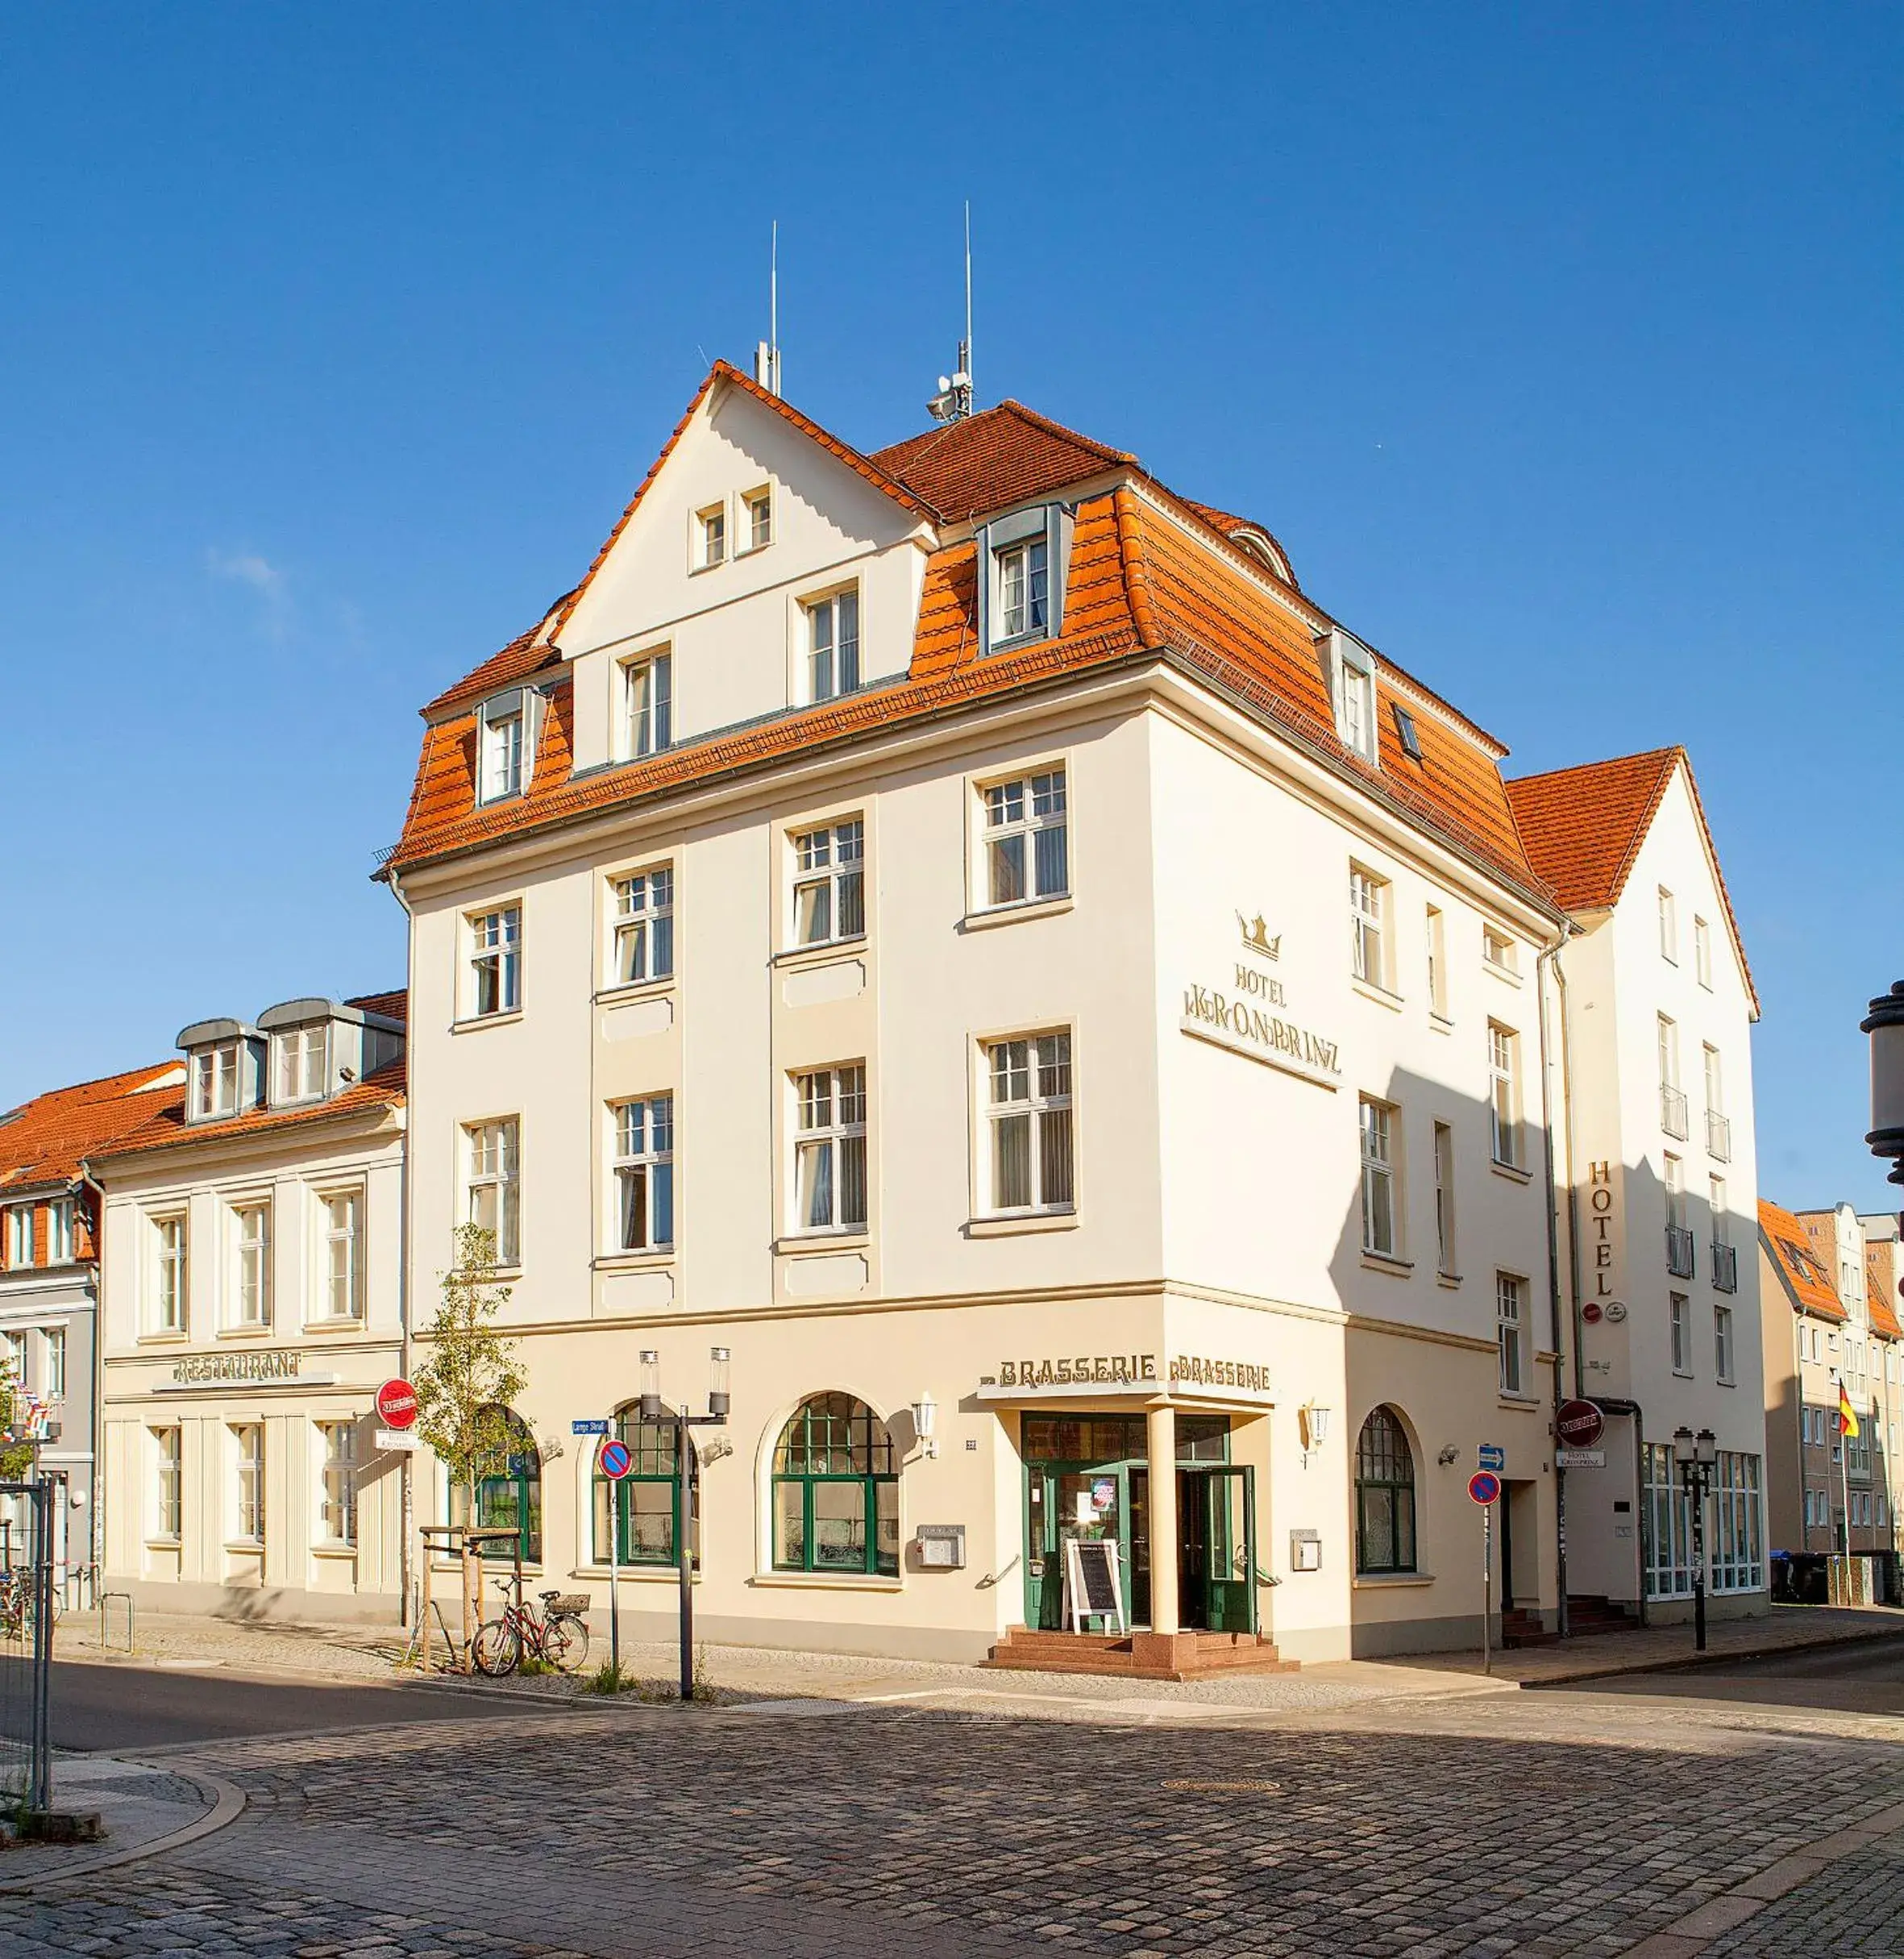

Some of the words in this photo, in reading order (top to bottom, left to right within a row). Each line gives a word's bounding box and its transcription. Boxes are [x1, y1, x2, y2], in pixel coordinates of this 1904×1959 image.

[1234, 963, 1287, 1009] HOTEL
[1189, 983, 1342, 1075] KRONPRINZ
[1589, 1160, 1613, 1296] HOTEL
[175, 1351, 301, 1384] RESTAURANT
[1000, 1354, 1157, 1389] BRASSERIE
[1178, 1354, 1270, 1392] BRASSERIE
